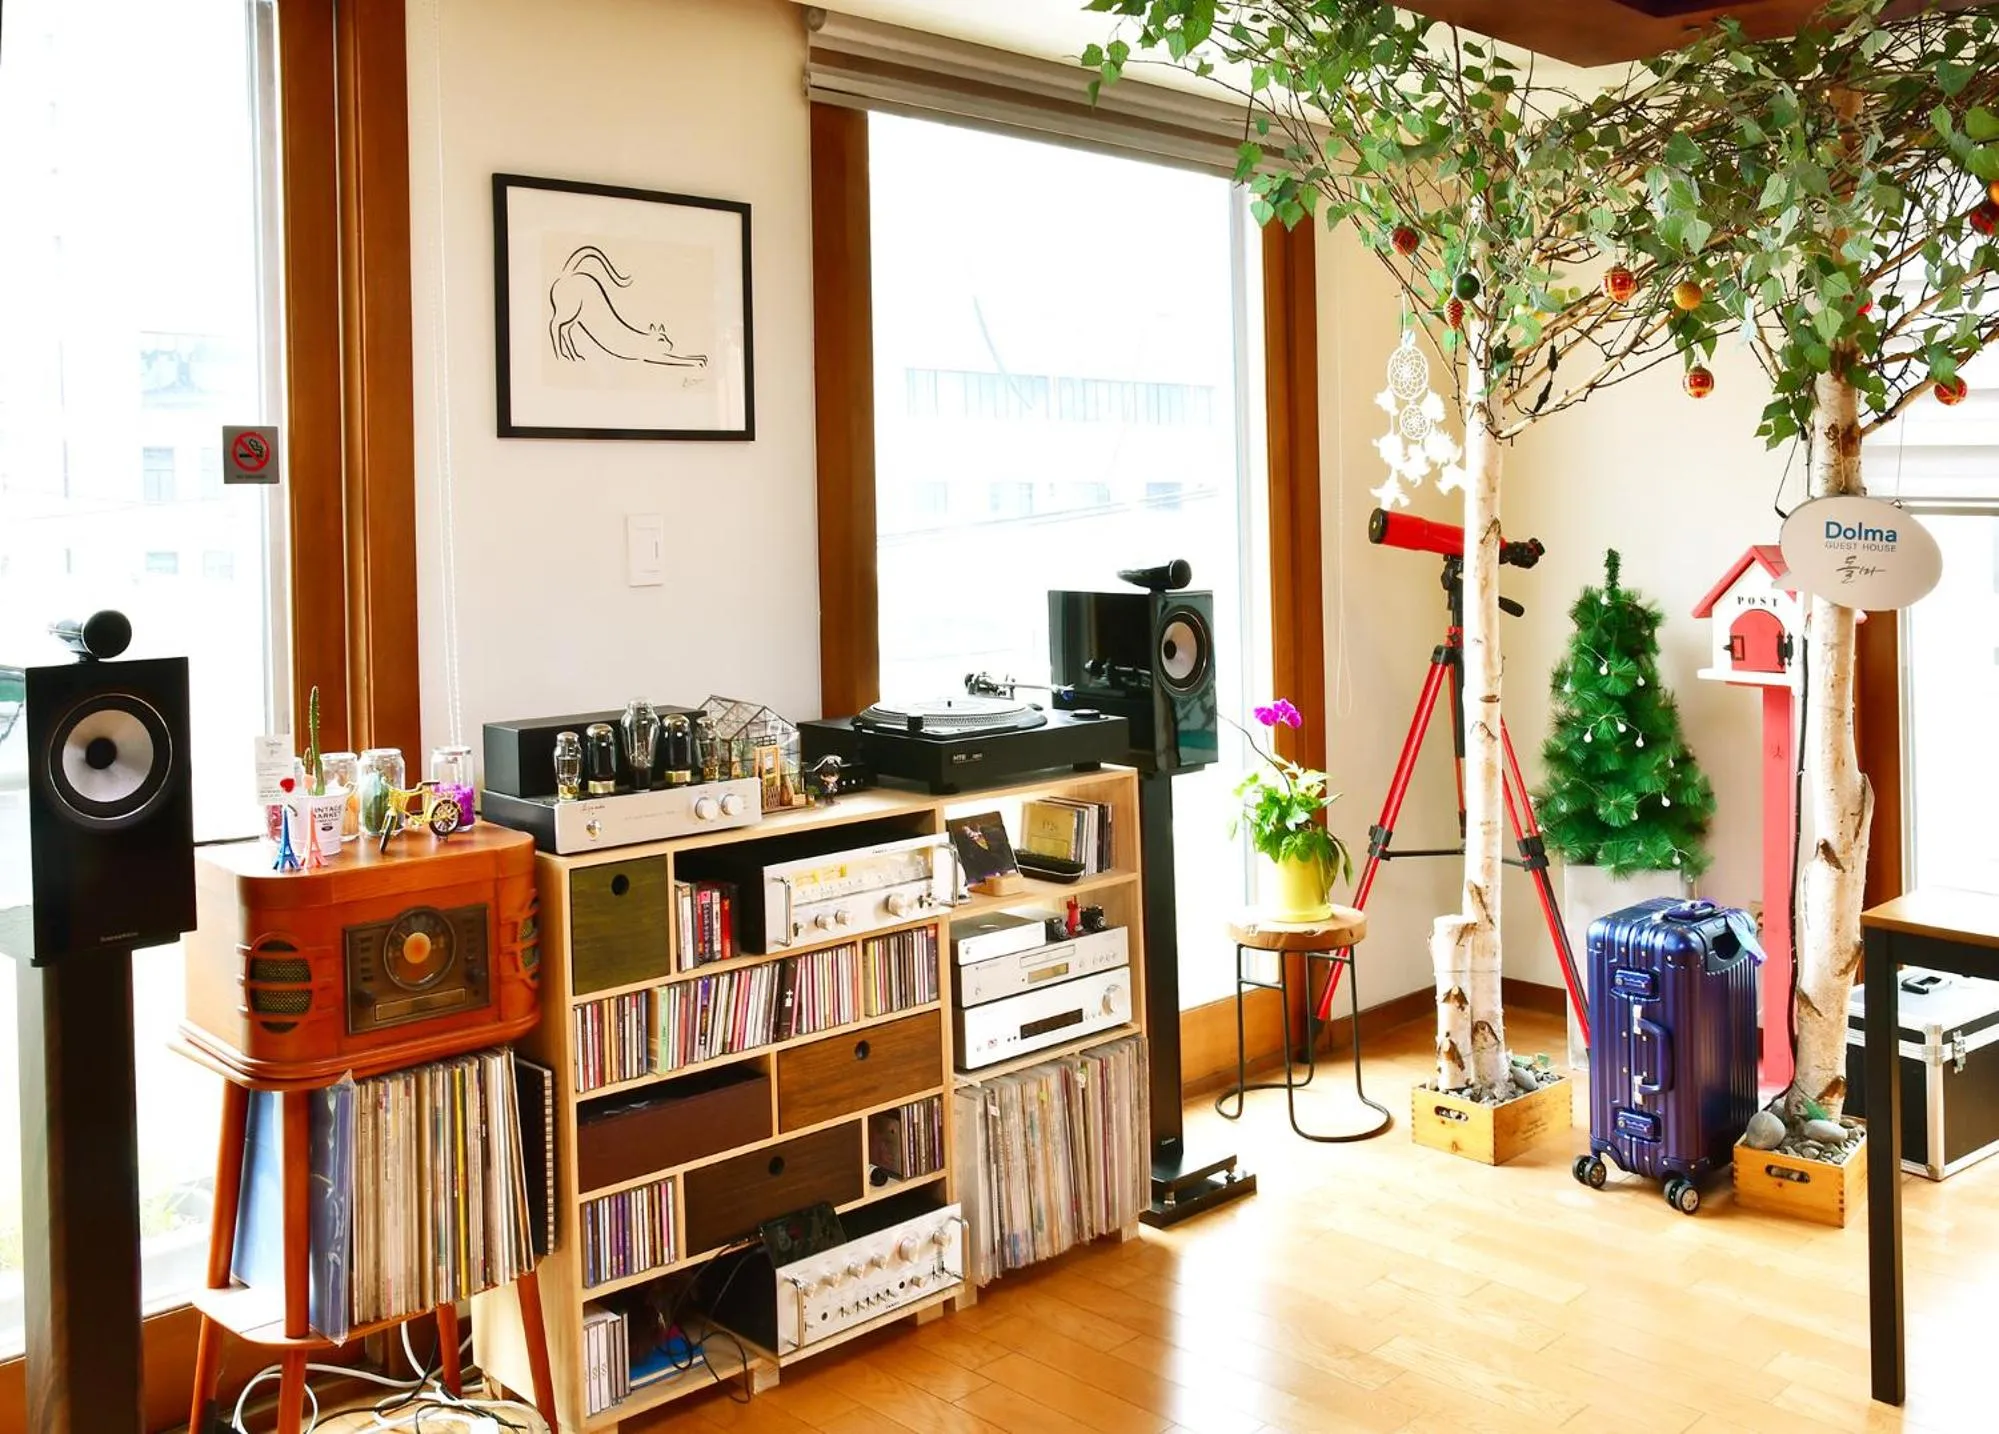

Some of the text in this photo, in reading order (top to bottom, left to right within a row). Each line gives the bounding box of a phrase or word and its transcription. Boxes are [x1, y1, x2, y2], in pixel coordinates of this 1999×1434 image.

[1825, 521, 1897, 542] Dolma
[1825, 541, 1897, 552] GUEST HOUSE
[1737, 595, 1778, 608] POST
